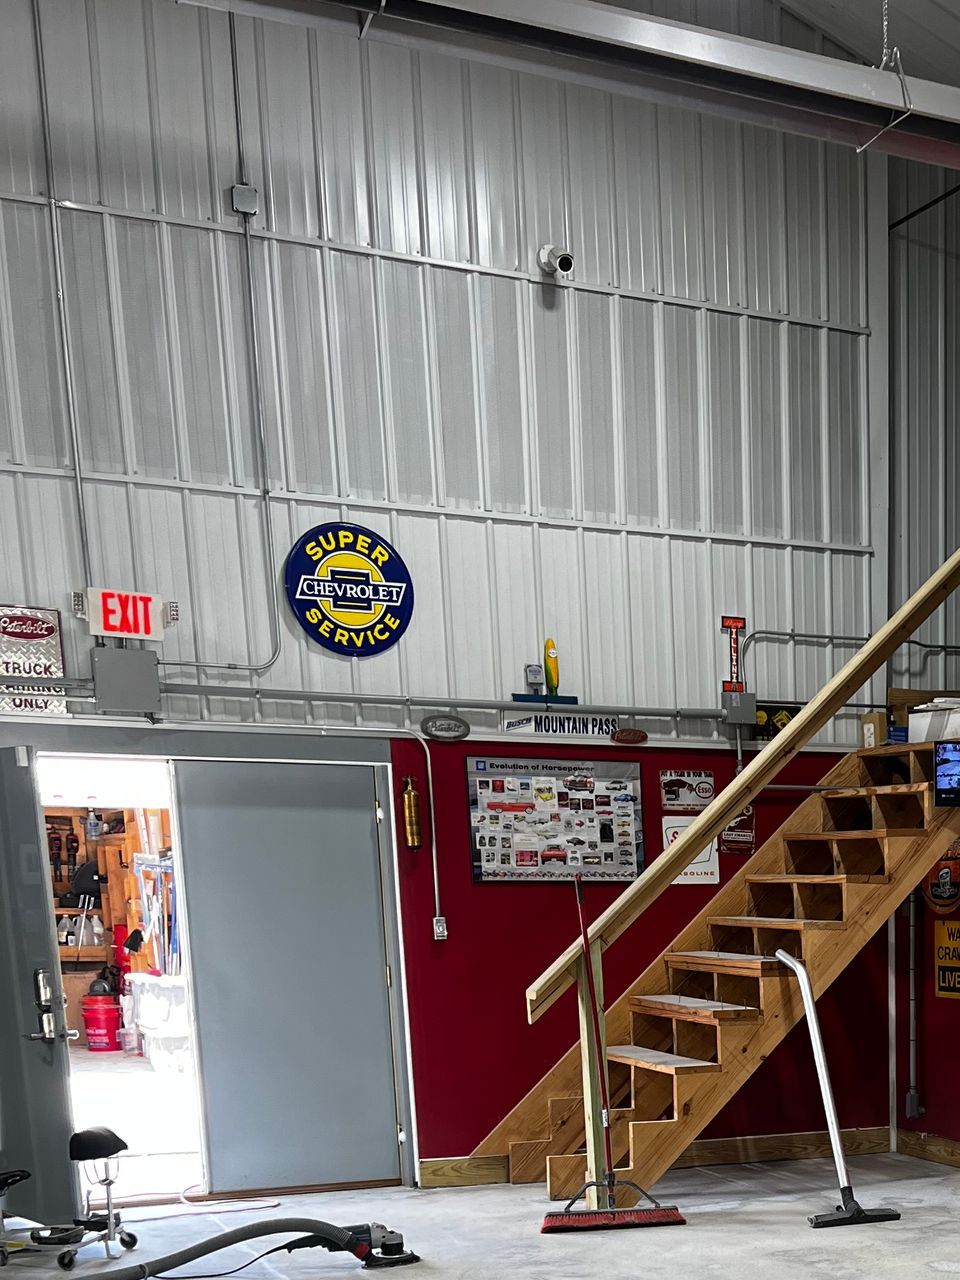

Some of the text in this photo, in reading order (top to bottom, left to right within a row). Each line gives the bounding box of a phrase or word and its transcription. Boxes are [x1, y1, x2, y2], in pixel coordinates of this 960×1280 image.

[305, 530, 390, 567] SUPER
[303, 581, 401, 601] CHEVROLET
[101, 592, 153, 635] EXIT
[0, 617, 52, 634] Peterbilt
[305, 608, 401, 648] SERVICE
[2, 661, 54, 676] TRUCK
[12, 698, 49, 710] ONLY
[505, 714, 617, 736] BUSCH MOUNTAIN PASS
[489, 761, 529, 771] Evolution
[542, 764, 595, 773] Horsepower
